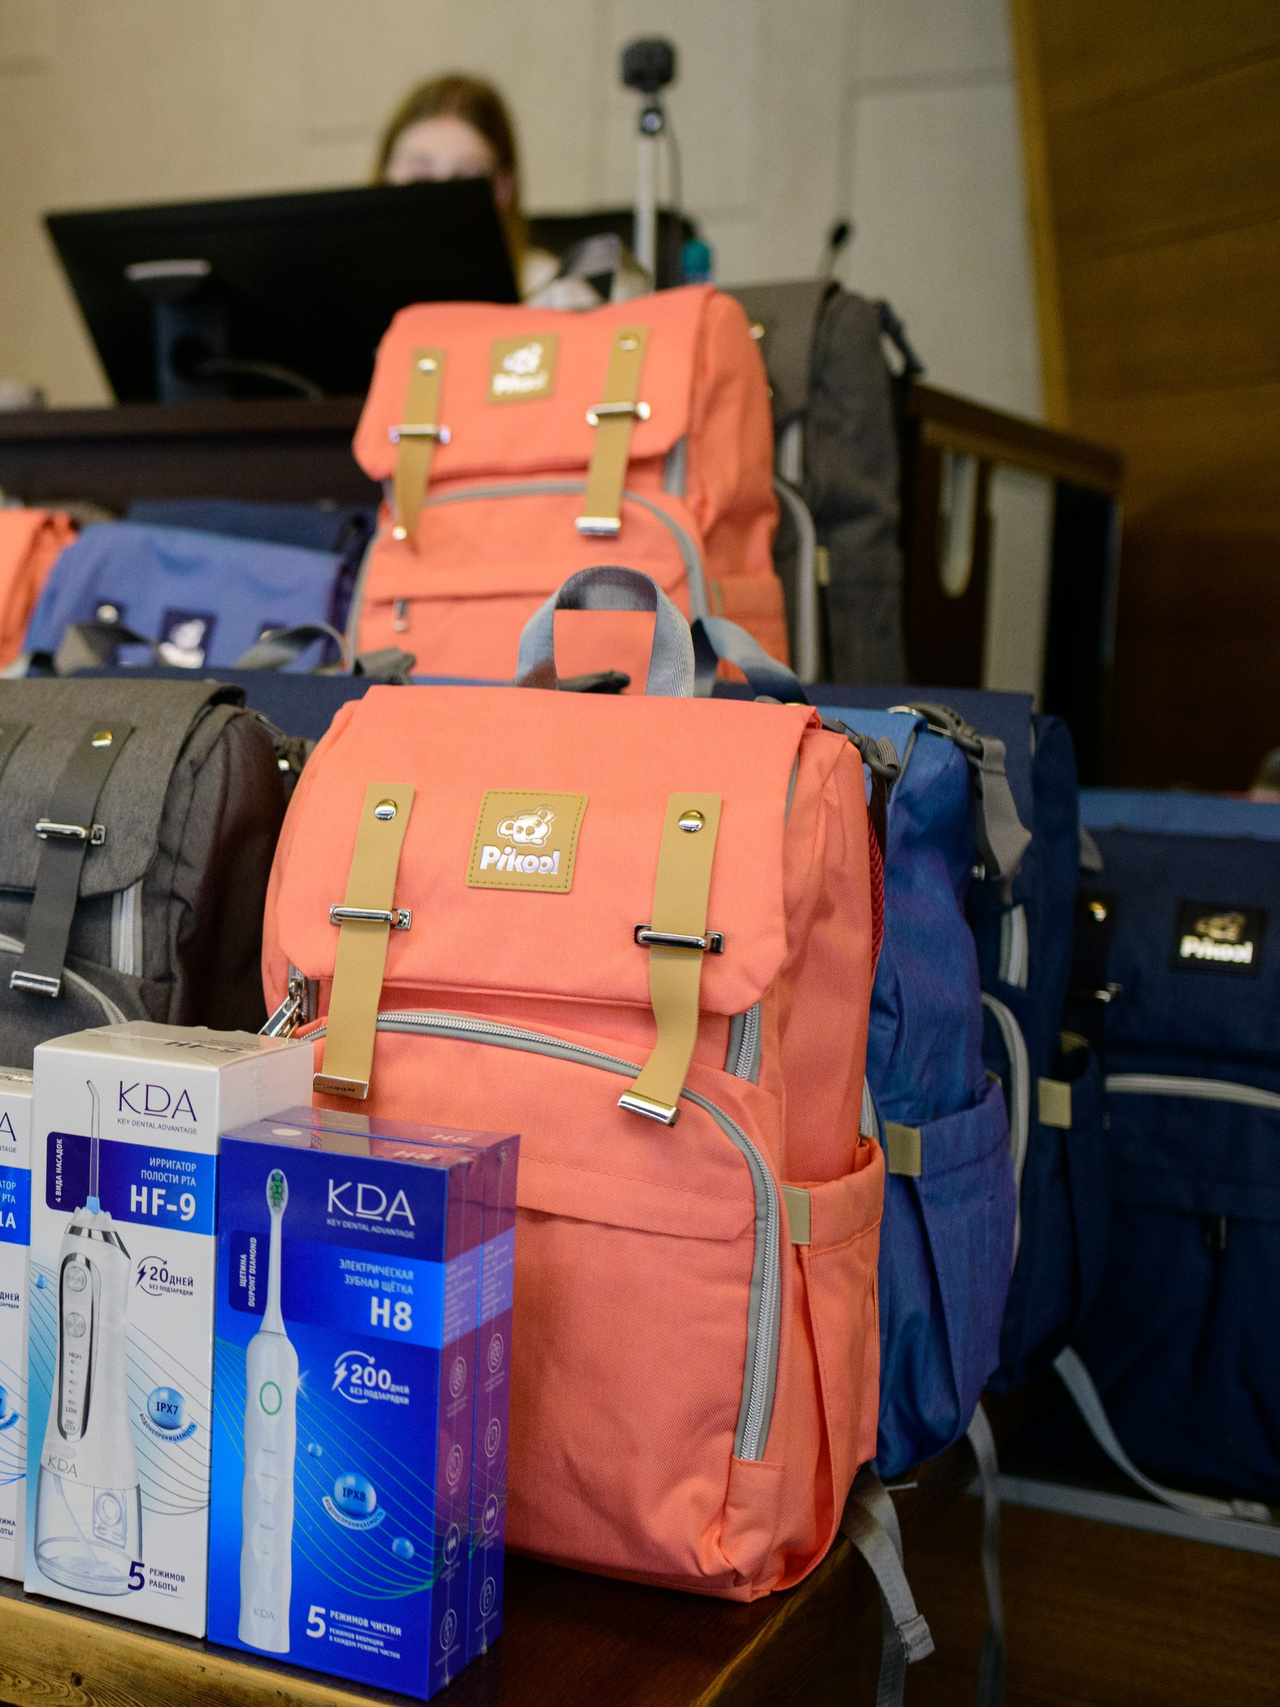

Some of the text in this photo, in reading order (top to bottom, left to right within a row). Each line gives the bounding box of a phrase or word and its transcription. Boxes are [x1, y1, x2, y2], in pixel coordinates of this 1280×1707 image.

[479, 845, 561, 875] Pikool
[118, 1080, 197, 1122] KDA
[117, 1118, 198, 1135] KEY DENTAL ADVANTAGE
[55, 1138, 64, 1174] НАСАДОК
[149, 1157, 197, 1173] ИРРИГАТОР
[55, 1174, 63, 1196] ВИДА
[141, 1169, 196, 1187] ПОЛОСТИ РТА
[1, 1193, 16, 1204] РТА
[130, 1184, 196, 1221] HF-9
[327, 1178, 416, 1226] KDA
[326, 1218, 415, 1239] KEY DENTAL ADVANTAGE
[149, 1266, 194, 1287] 20 ДНЕЙ
[239, 1254, 247, 1288] ЩЕТИНА
[248, 1237, 257, 1307] DUPONT DIAMOND
[339, 1258, 414, 1280] ЭЛЕКТРИЧЕСКАЯ
[159, 1285, 194, 1296] ПОДЗАРЯДКИ
[344, 1274, 413, 1296] ЗУБНАЯ ЩЁТКА
[0, 1292, 19, 1302] ДНЕЙ
[370, 1296, 413, 1332] H8
[68, 1351, 81, 1360] HIGH
[350, 1363, 391, 1390] 200
[349, 1386, 363, 1397] БЕЗ
[65, 1405, 78, 1414] LOW
[156, 1401, 178, 1415] IPX7
[138, 1413, 196, 1442] ВОДОНЕПРОНИЦАЕМОСТЬ
[47, 1454, 78, 1478] KDA
[342, 1487, 366, 1501] IPX8
[127, 1560, 185, 1591] 5 РЕЖИМОВ
[149, 1579, 178, 1592] РАБОТЫ
[306, 1605, 402, 1638] 5 РЕЖИМОВ ЧИСТКИ
